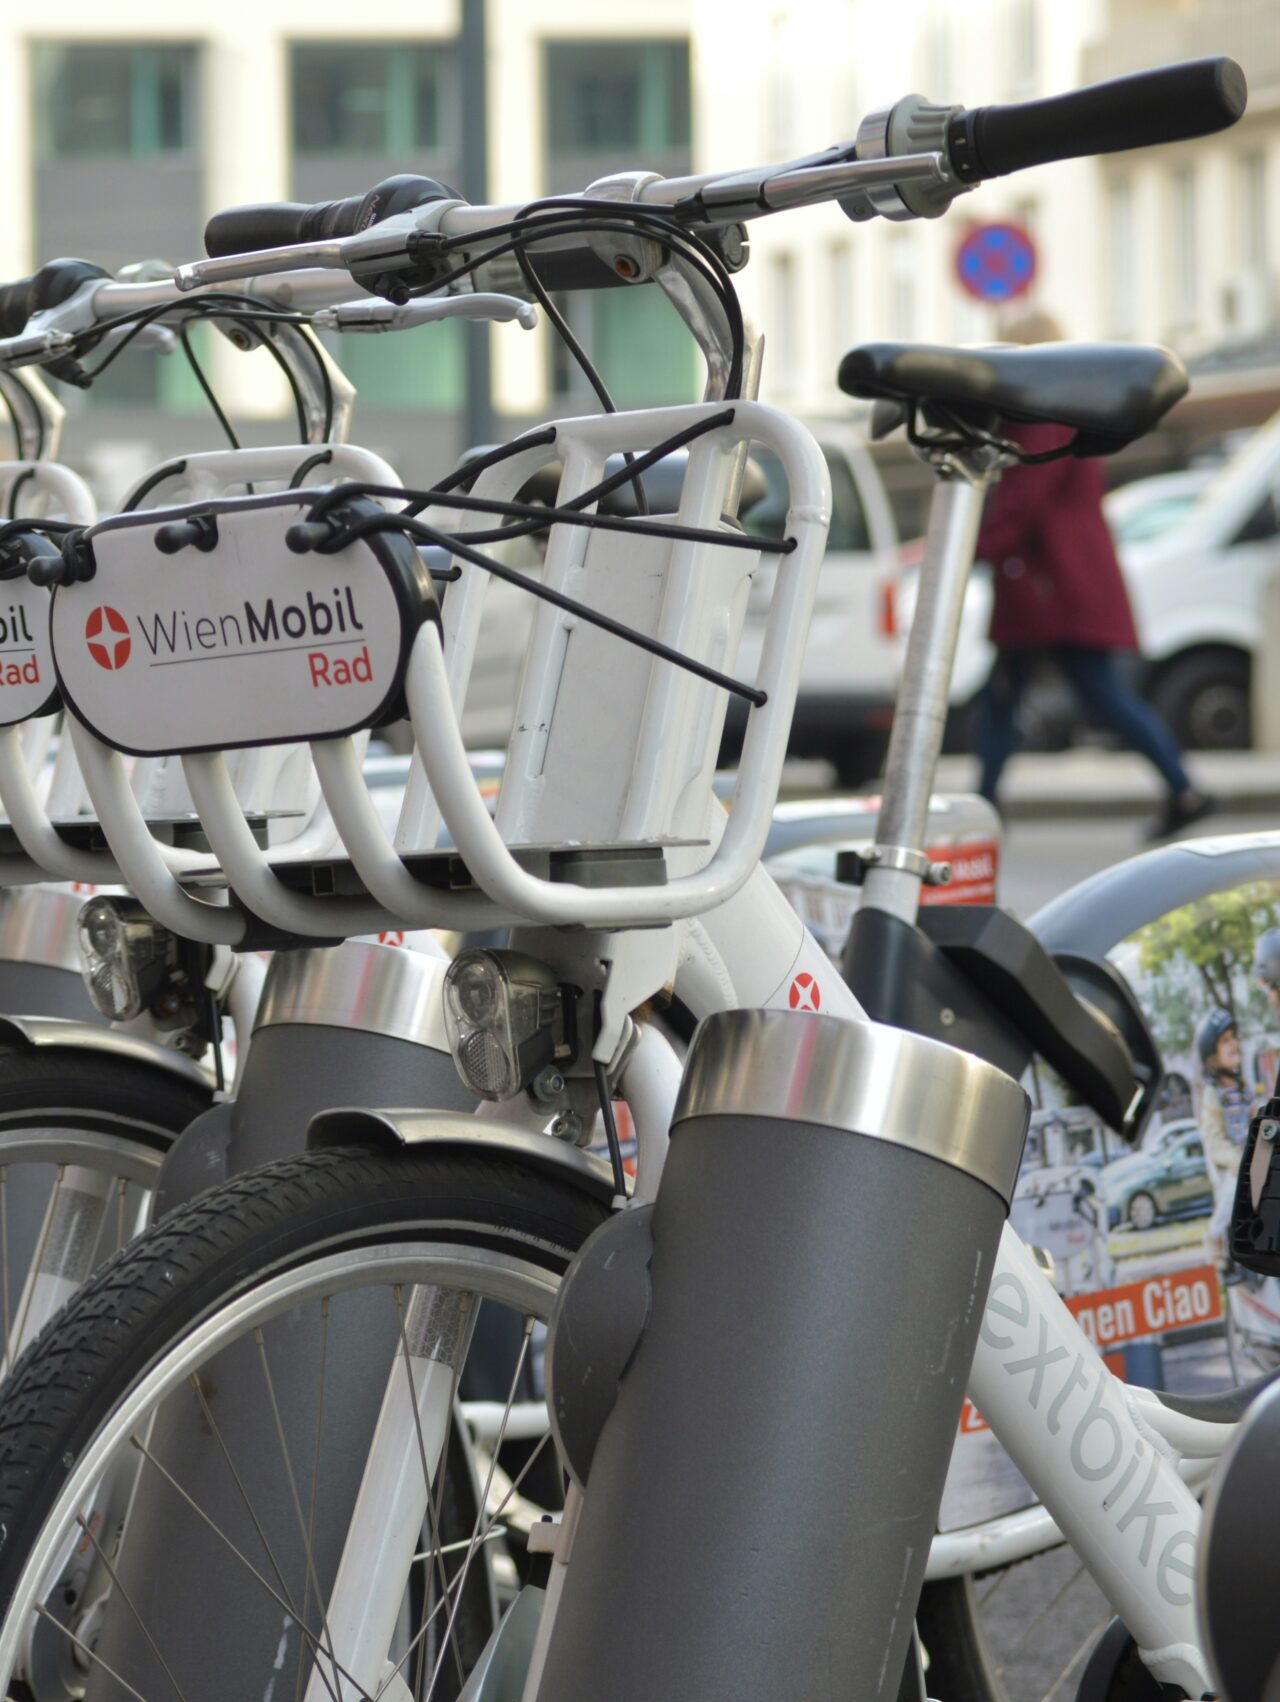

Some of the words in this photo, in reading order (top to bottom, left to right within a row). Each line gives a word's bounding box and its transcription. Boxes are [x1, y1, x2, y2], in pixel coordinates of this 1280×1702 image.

[136, 586, 364, 655] WienMobil
[308, 646, 373, 687] Rad
[1076, 1299, 1136, 1346] gen
[1142, 1279, 1211, 1328] Ciao
[979, 1271, 1196, 1607] extbike
